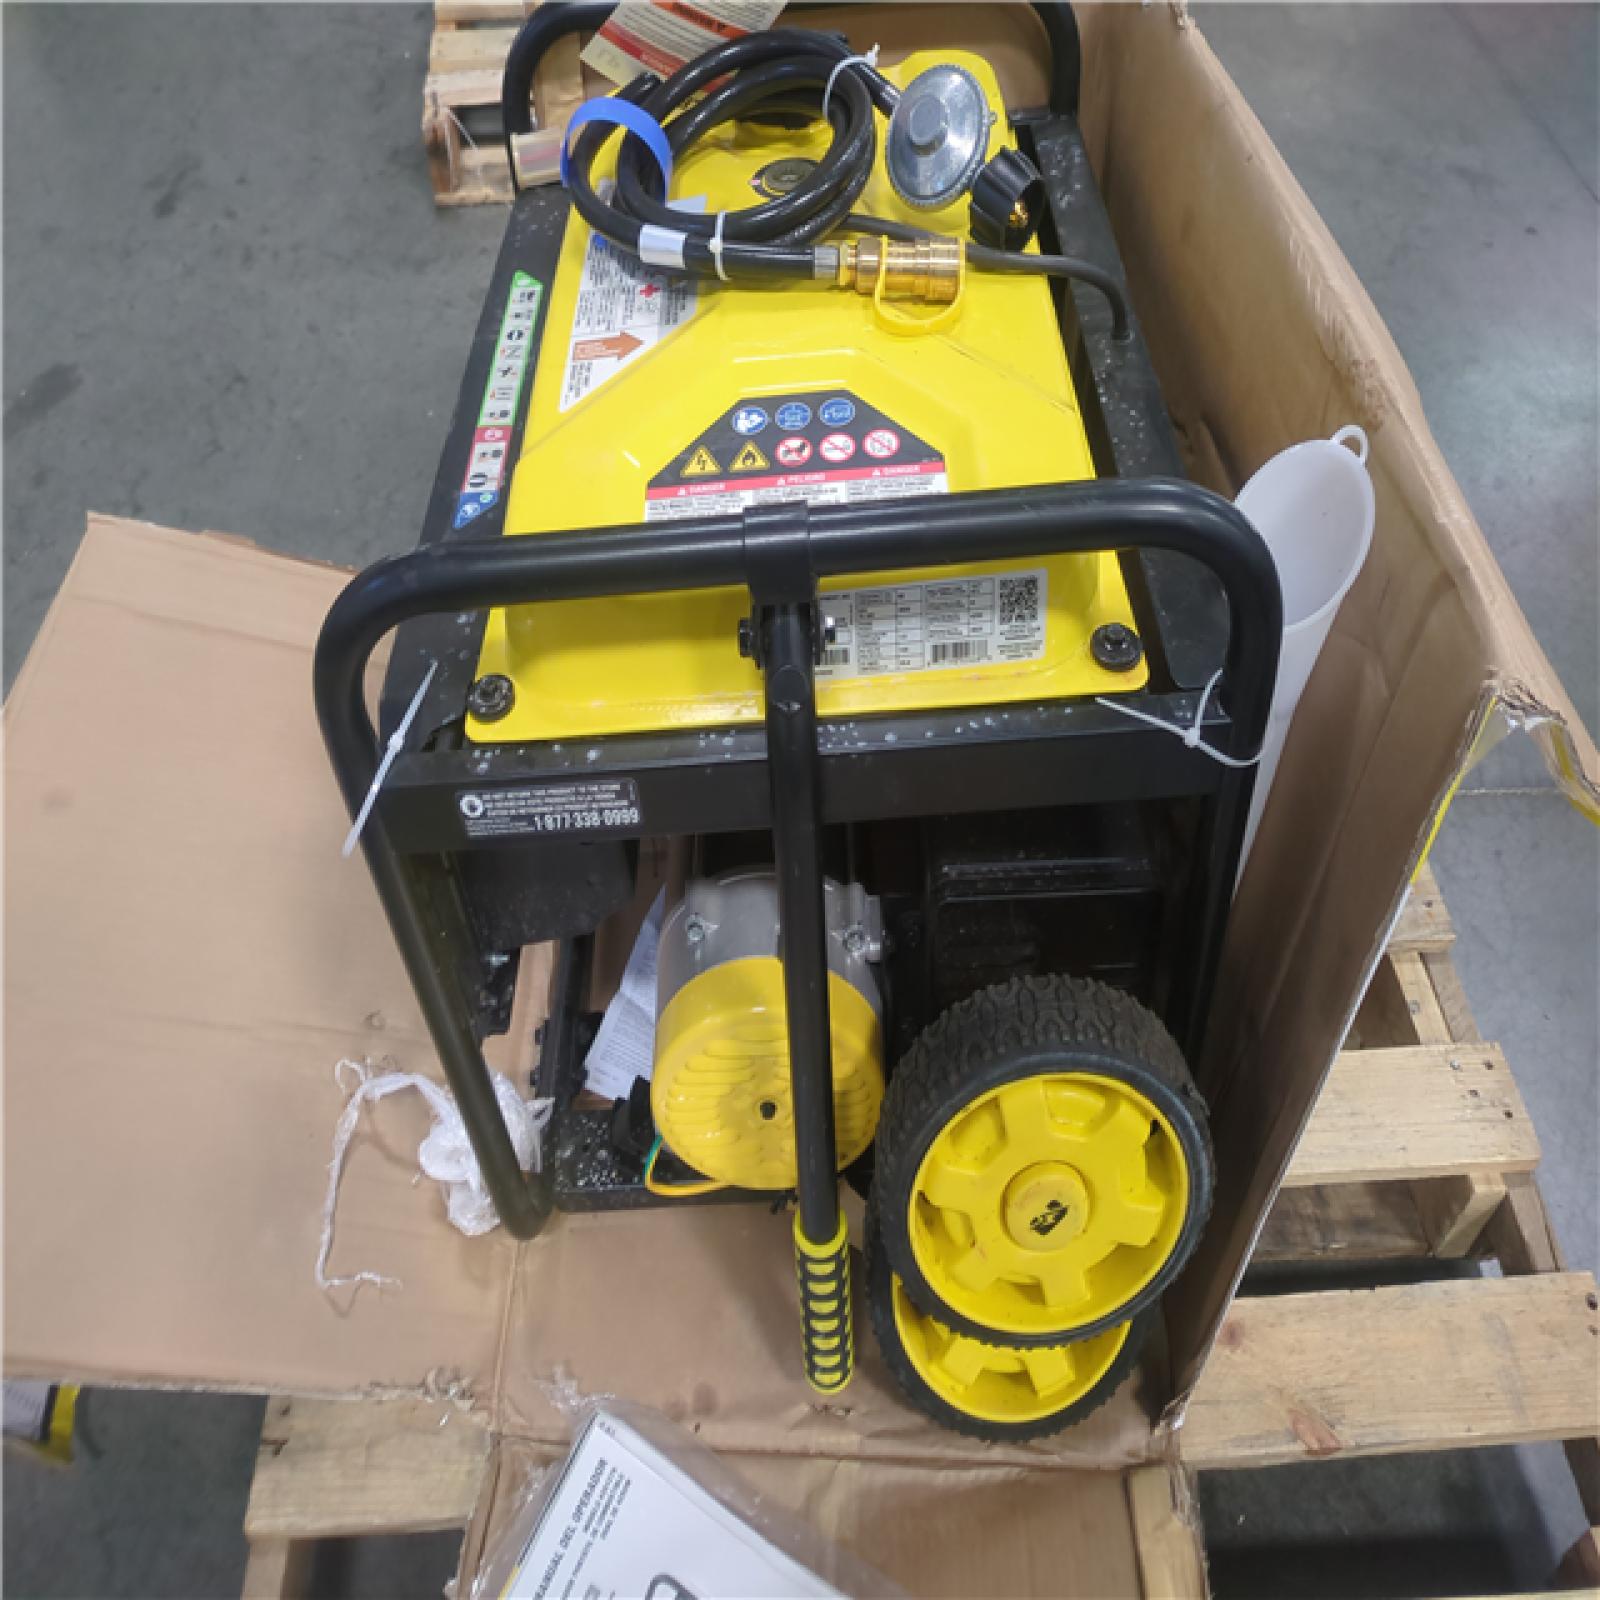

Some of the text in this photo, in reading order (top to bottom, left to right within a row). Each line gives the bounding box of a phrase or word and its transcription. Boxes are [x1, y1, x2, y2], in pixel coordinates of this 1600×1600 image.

[689, 483, 726, 494] DANGER
[558, 1524, 577, 1551] DEL
[571, 1456, 608, 1523] OPERADOR
